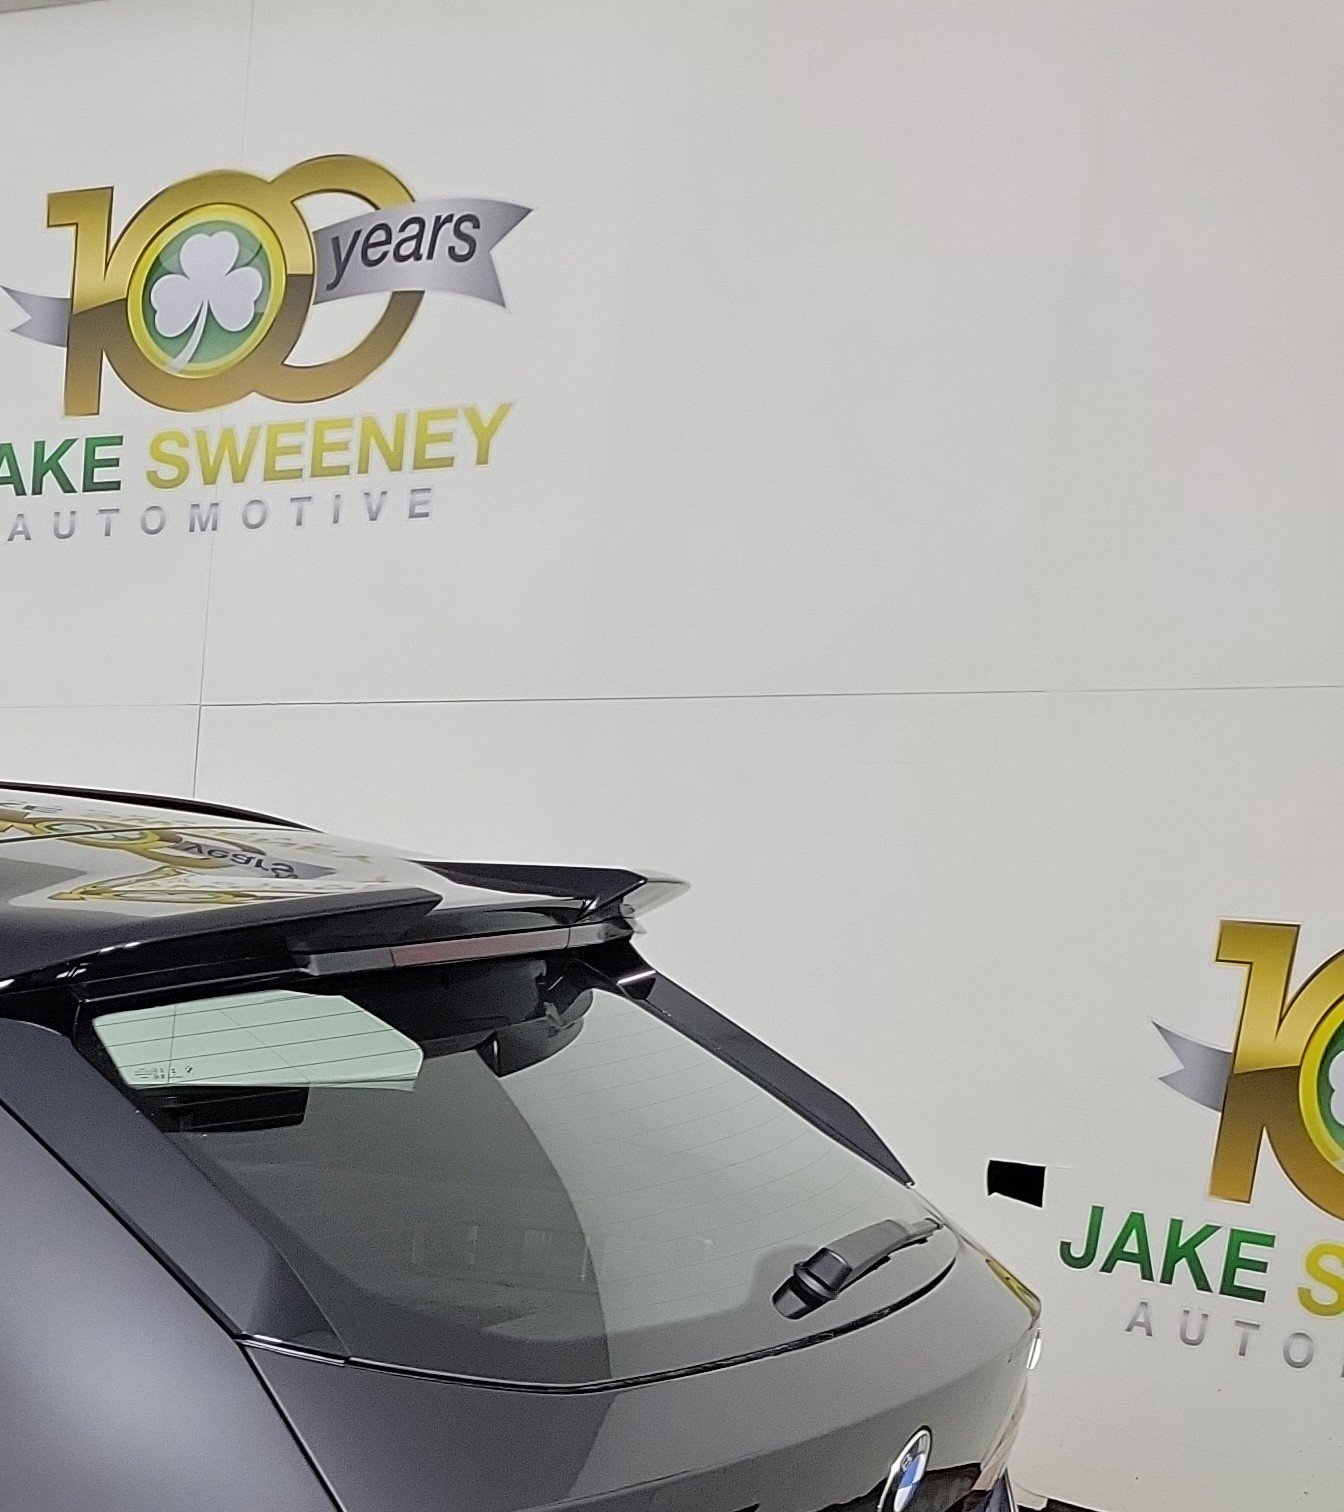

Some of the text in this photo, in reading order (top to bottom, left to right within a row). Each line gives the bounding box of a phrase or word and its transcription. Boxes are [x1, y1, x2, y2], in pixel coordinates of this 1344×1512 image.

[46, 153, 481, 417] 100 years
[145, 402, 514, 490] SWEENEY
[7, 487, 433, 542] AUTOMOTIVE
[1059, 1205, 1276, 1303] JAKE
[1124, 1301, 1344, 1379] AUTO
